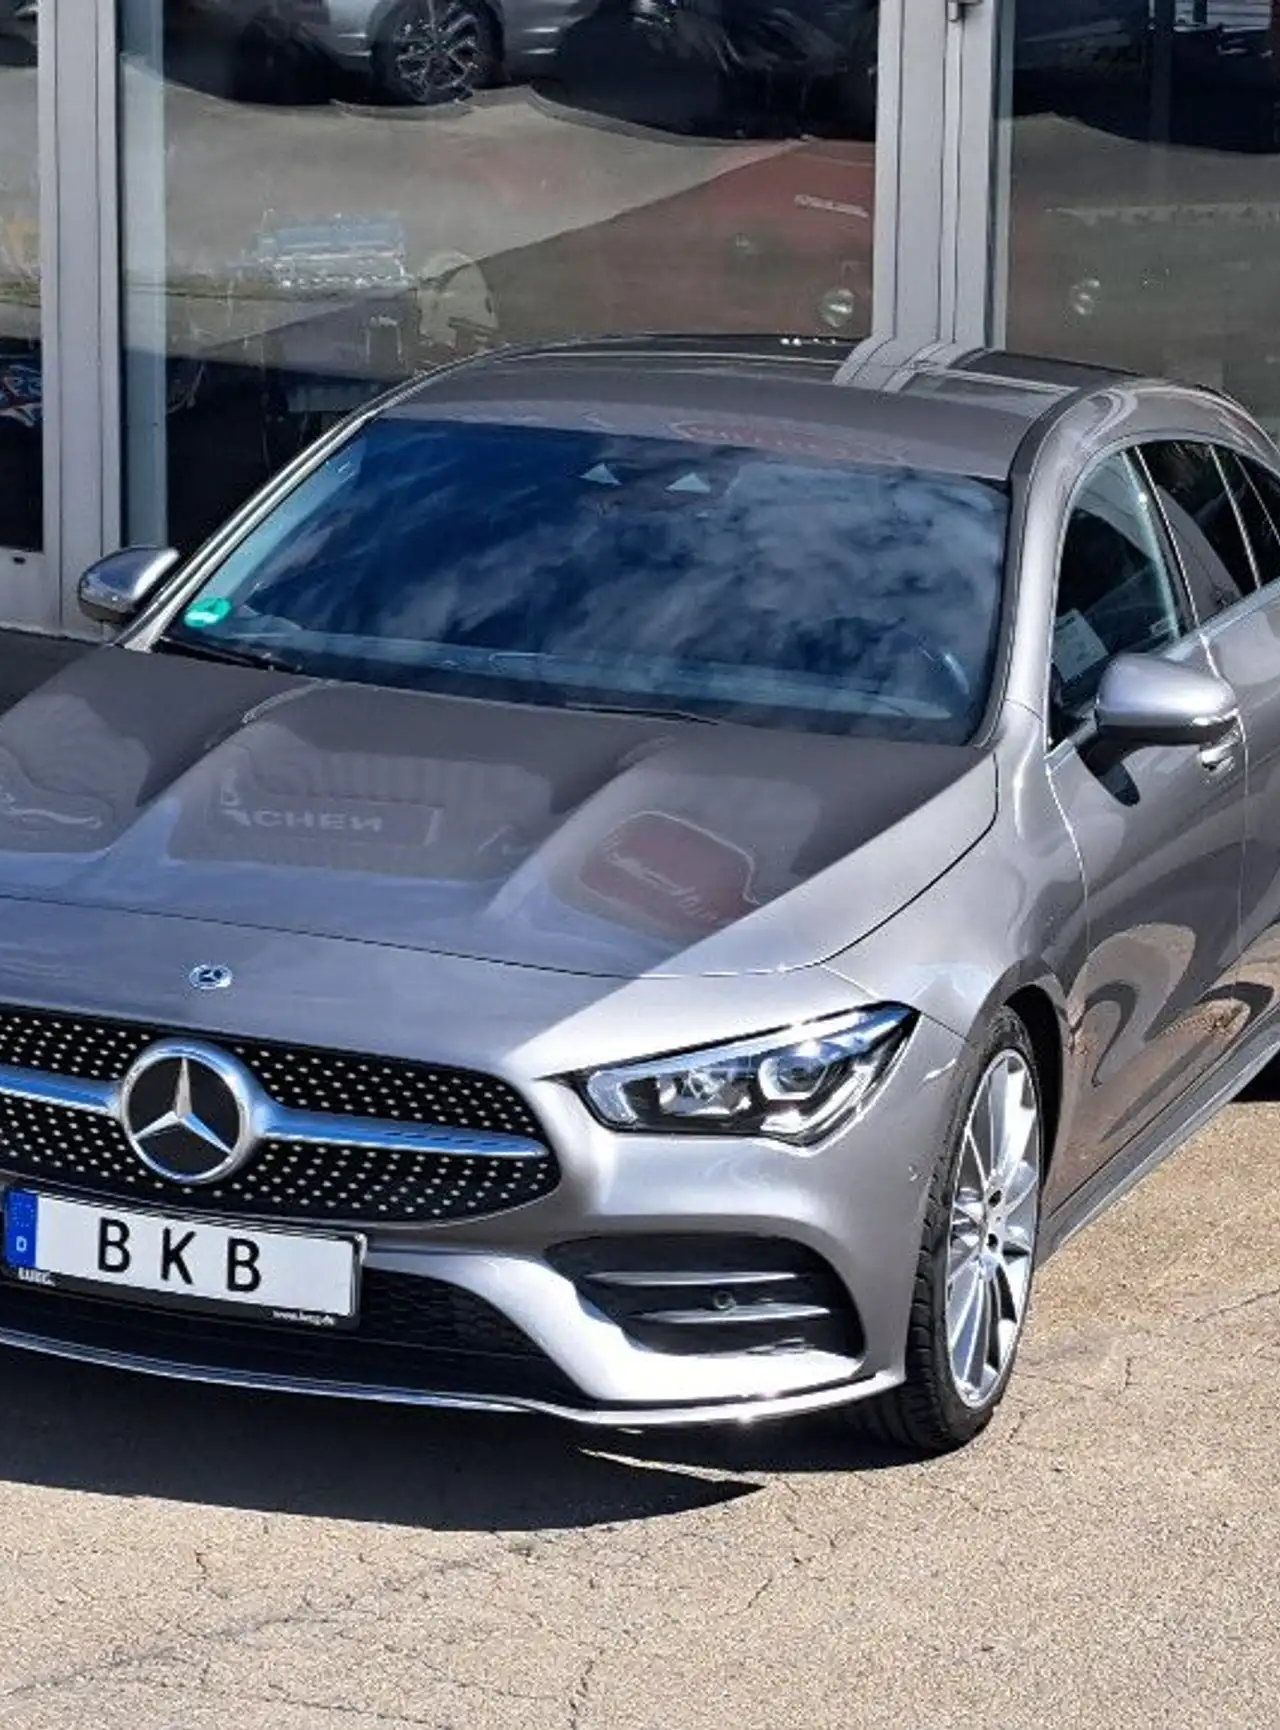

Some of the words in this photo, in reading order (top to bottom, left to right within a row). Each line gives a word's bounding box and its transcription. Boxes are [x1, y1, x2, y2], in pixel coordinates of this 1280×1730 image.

[16, 1235, 28, 1253] D
[97, 1217, 132, 1273] B
[160, 1226, 197, 1286] K
[226, 1236, 262, 1293] B
